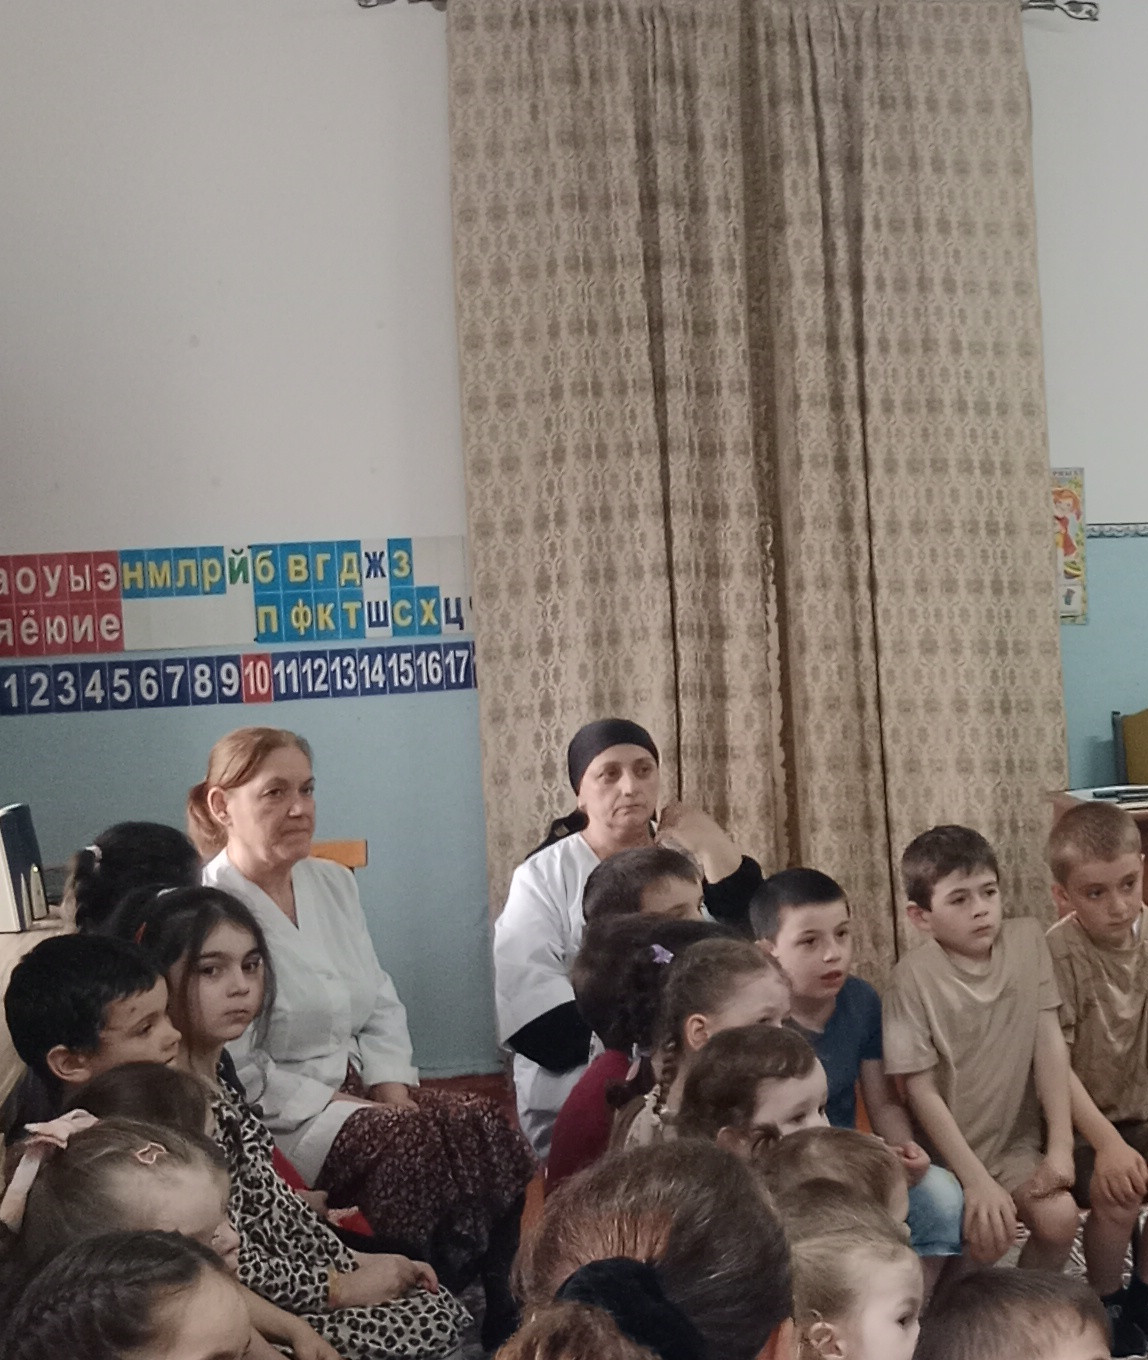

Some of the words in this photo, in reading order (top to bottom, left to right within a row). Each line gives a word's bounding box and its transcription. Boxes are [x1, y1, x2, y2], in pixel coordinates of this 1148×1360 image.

[16, 566, 37, 595] о
[42, 564, 62, 597] у
[69, 564, 91, 592] ы
[96, 562, 118, 591] э
[20, 609, 39, 645] ё
[46, 615, 67, 645] ю
[72, 614, 95, 643] и
[100, 613, 121, 641] е
[4, 673, 18, 708] 1
[29, 672, 50, 707] 2
[57, 671, 77, 706] 3
[84, 669, 105, 704] 4
[112, 668, 131, 702] 5
[139, 667, 159, 701] 6
[165, 665, 185, 700] 7
[193, 664, 213, 698] 8
[220, 662, 240, 696] 9
[244, 660, 270, 695] 10
[273, 658, 299, 694] 11
[301, 658, 329, 691] 12
[330, 656, 358, 690] 13
[359, 654, 386, 688] 14
[387, 652, 414, 687] 15
[416, 651, 443, 685] 16
[445, 650, 470, 683] 17
